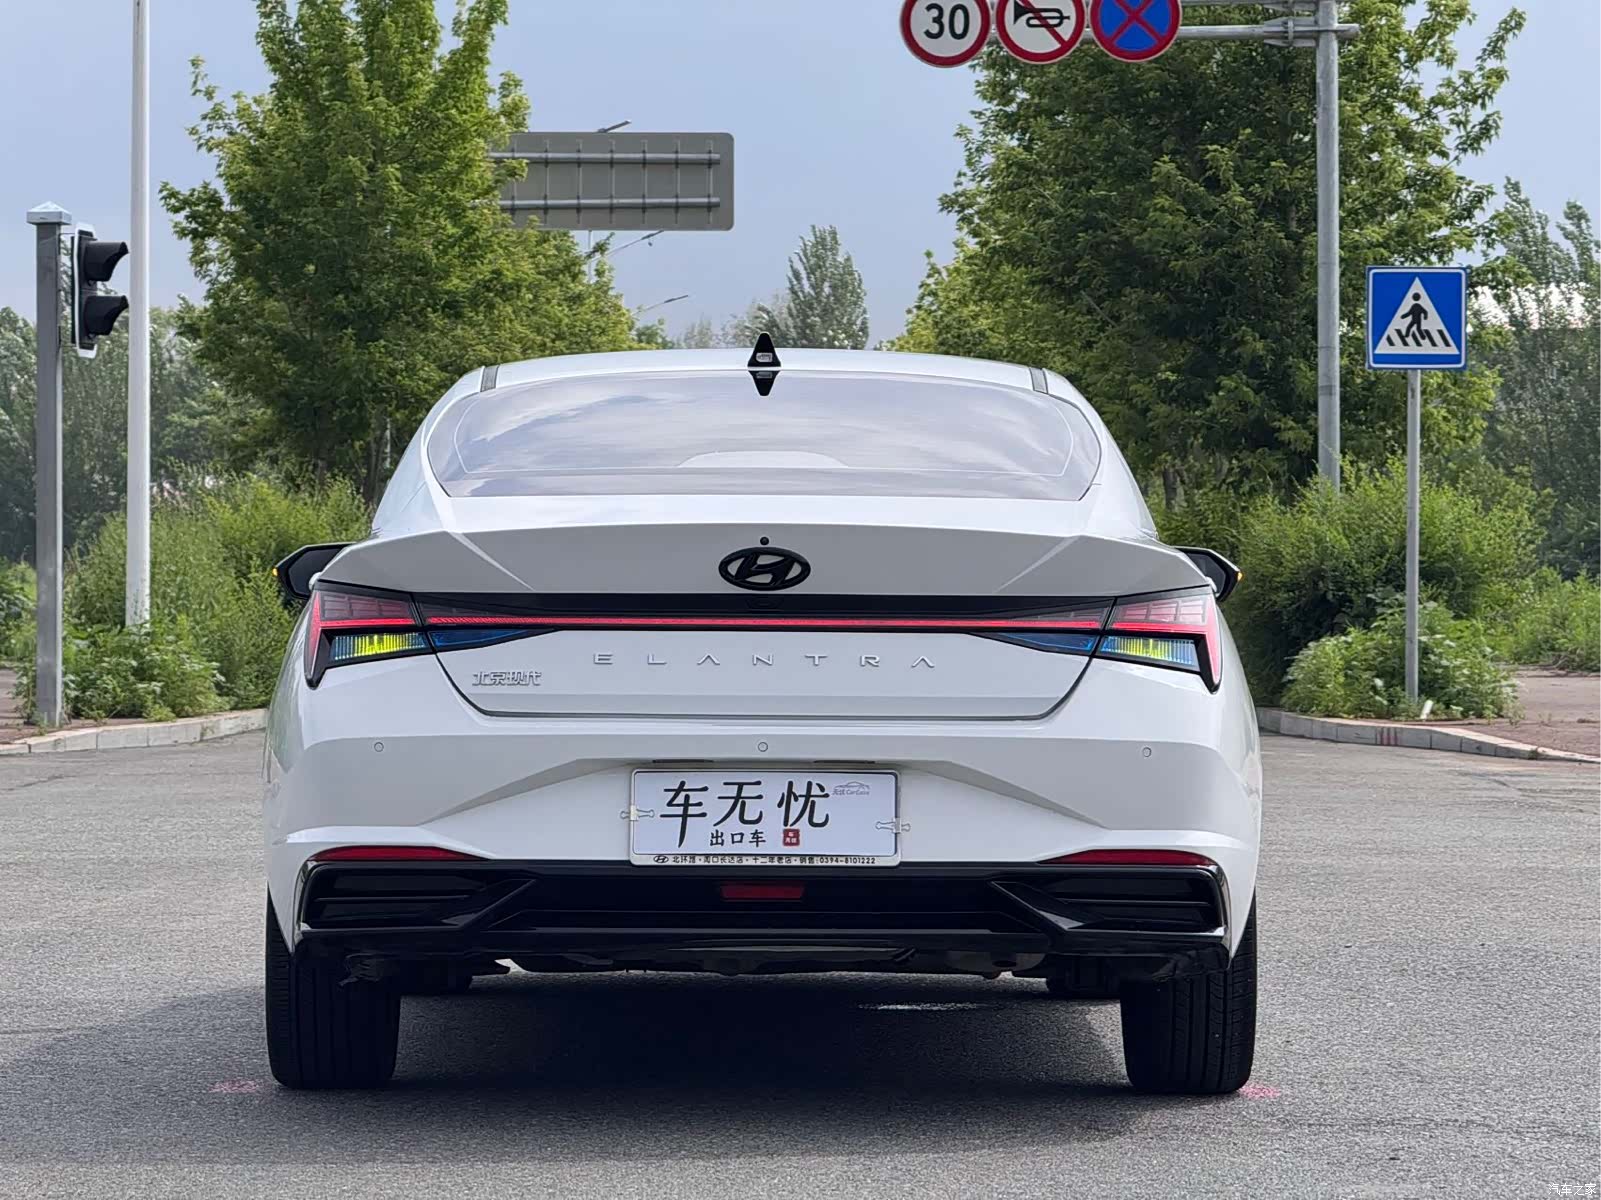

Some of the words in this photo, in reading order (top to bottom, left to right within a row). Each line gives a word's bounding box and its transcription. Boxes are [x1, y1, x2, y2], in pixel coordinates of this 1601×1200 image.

[924, 3, 970, 40] 30
[593, 652, 935, 668] ELANTRA
[471, 670, 542, 687] 北京现代
[659, 780, 831, 849] 车无忧
[709, 829, 766, 848] 出口车
